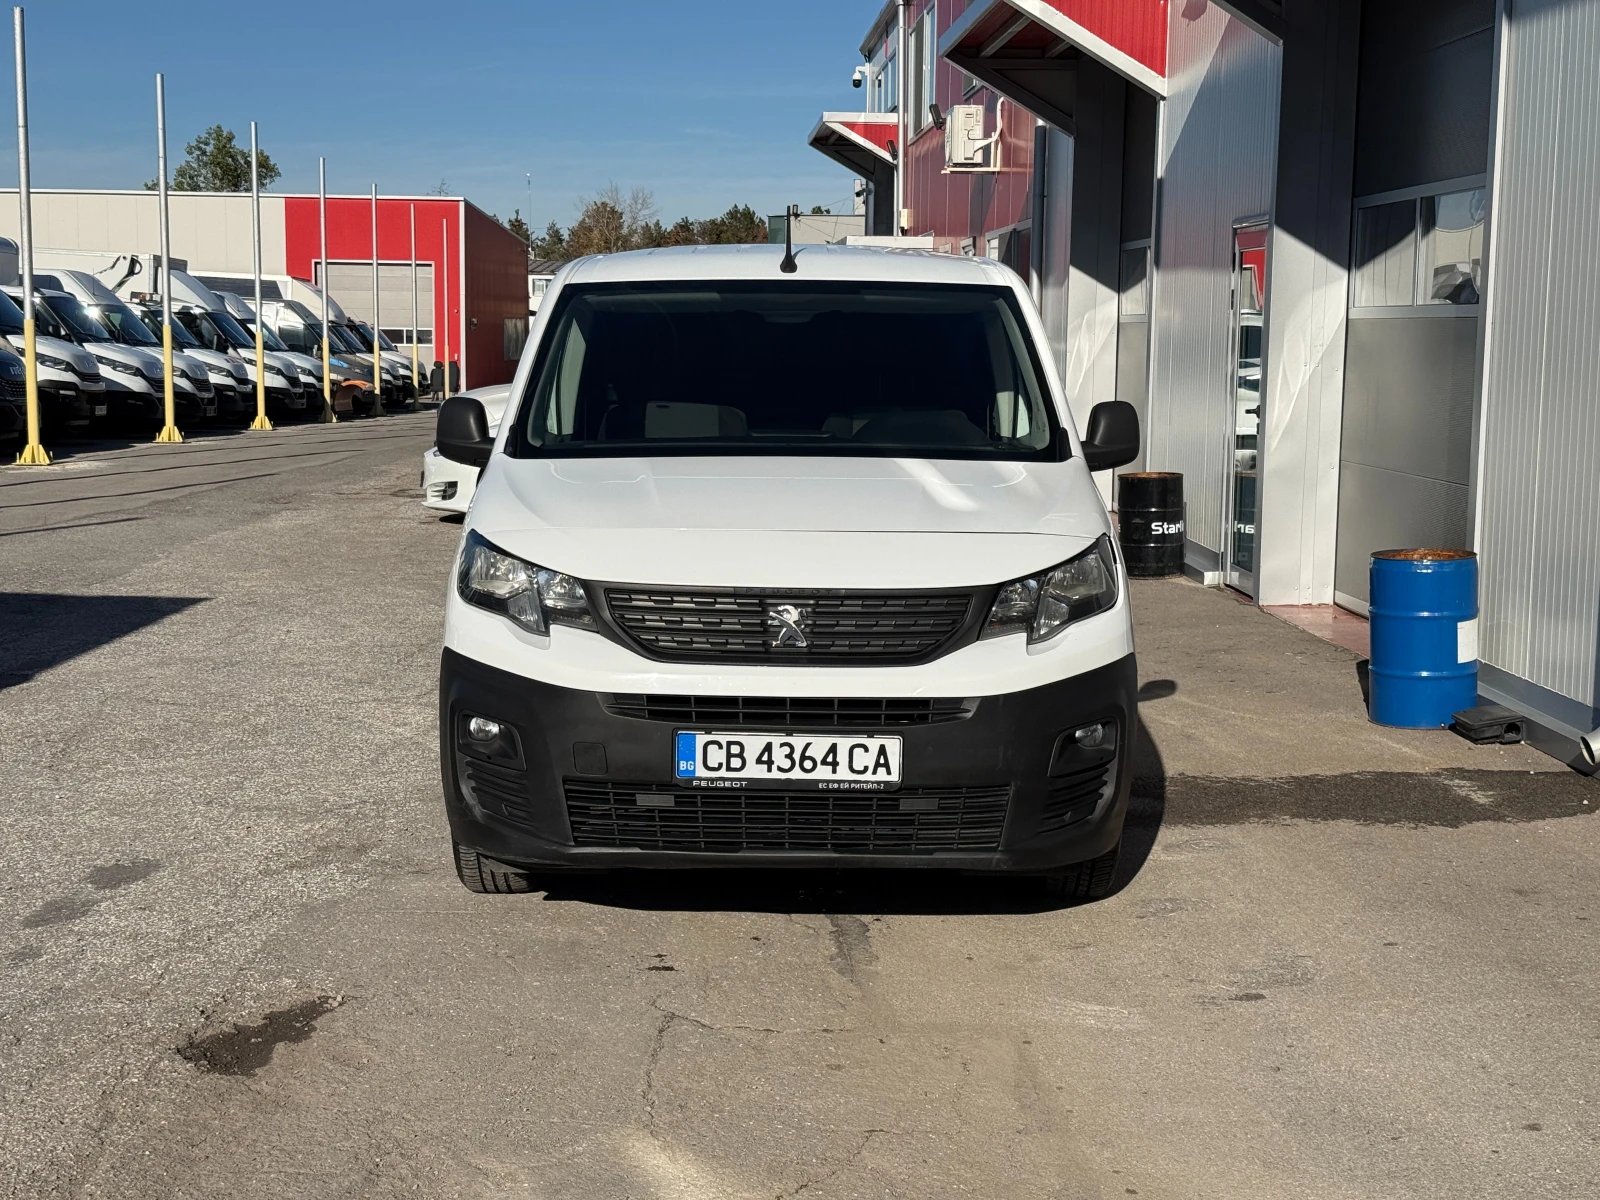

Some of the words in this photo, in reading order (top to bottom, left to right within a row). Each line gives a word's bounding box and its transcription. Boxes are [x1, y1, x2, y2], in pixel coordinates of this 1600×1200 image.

[702, 739, 747, 773] CB
[755, 741, 840, 775] 4364
[847, 743, 893, 776] CA
[679, 761, 695, 771] BG
[692, 780, 748, 788] PEUGEOT
